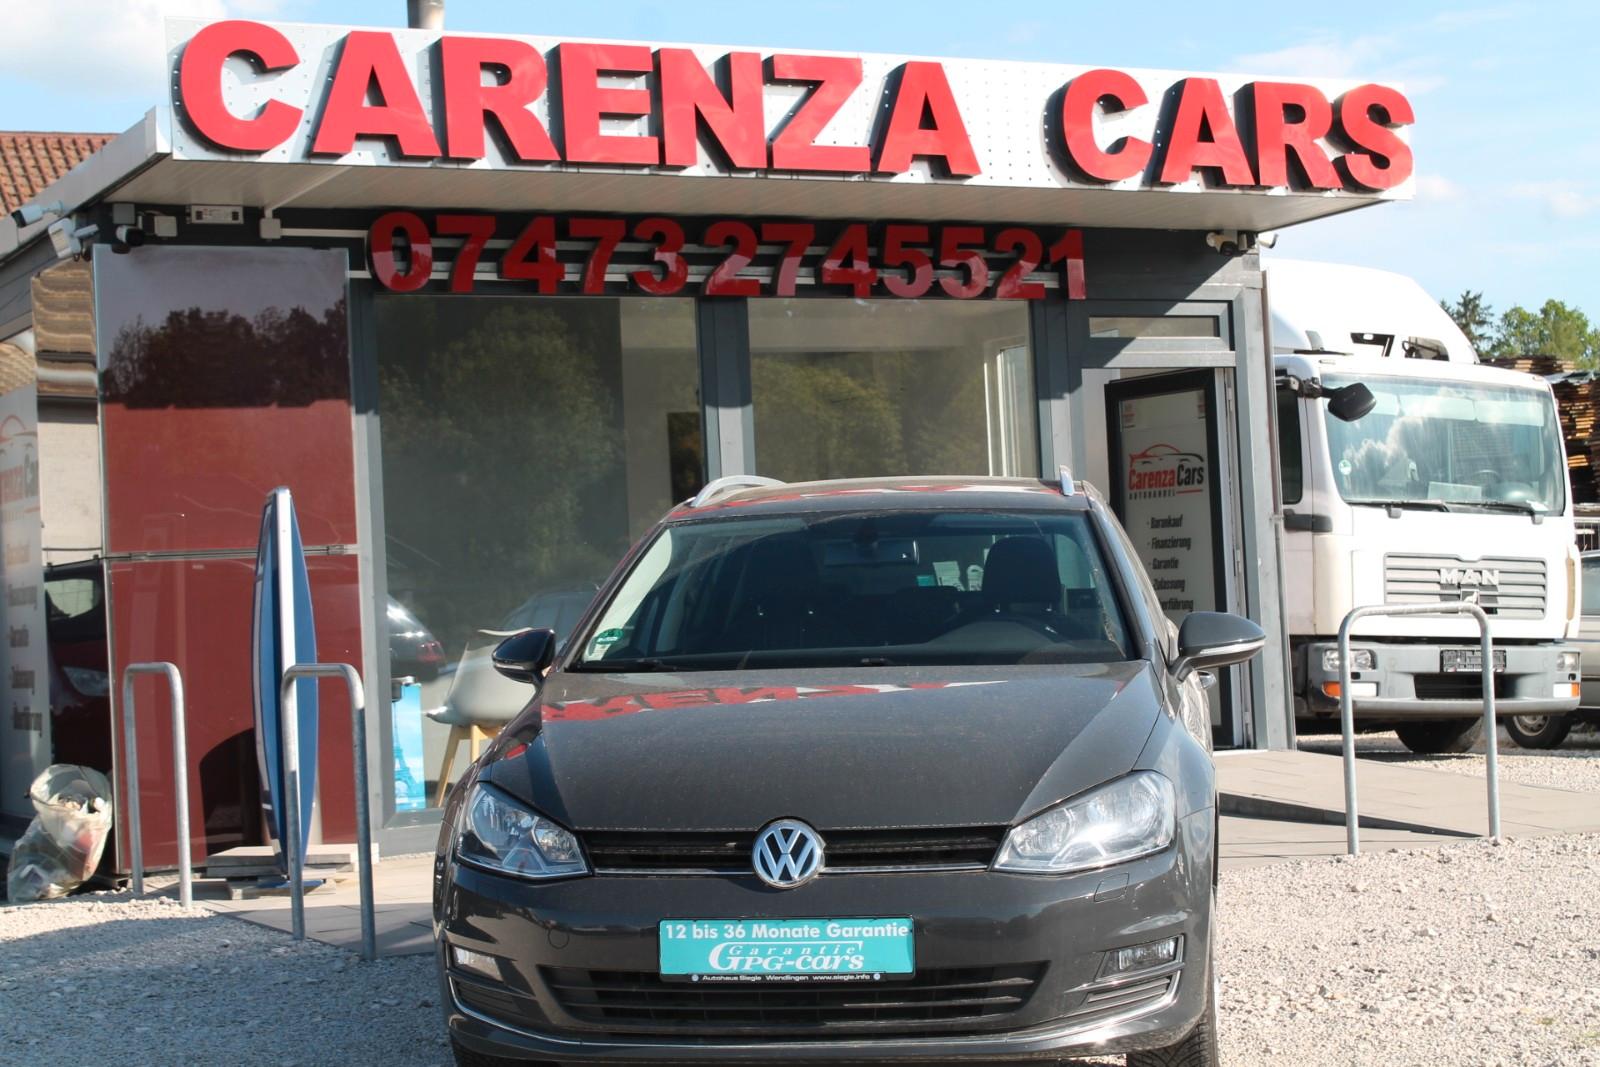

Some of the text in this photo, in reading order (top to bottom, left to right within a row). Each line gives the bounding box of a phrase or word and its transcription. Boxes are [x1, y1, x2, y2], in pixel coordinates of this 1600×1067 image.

[175, 20, 1415, 192] CARENZA CARS
[367, 211, 1085, 300] 07473 2745521
[1439, 567, 1500, 586] MAN
[666, 922, 909, 939] 12 bis 36 Monate Garantie
[702, 974, 738, 982] Autohaus
[739, 974, 762, 982] Siegle
[765, 974, 809, 982] Wendlingen
